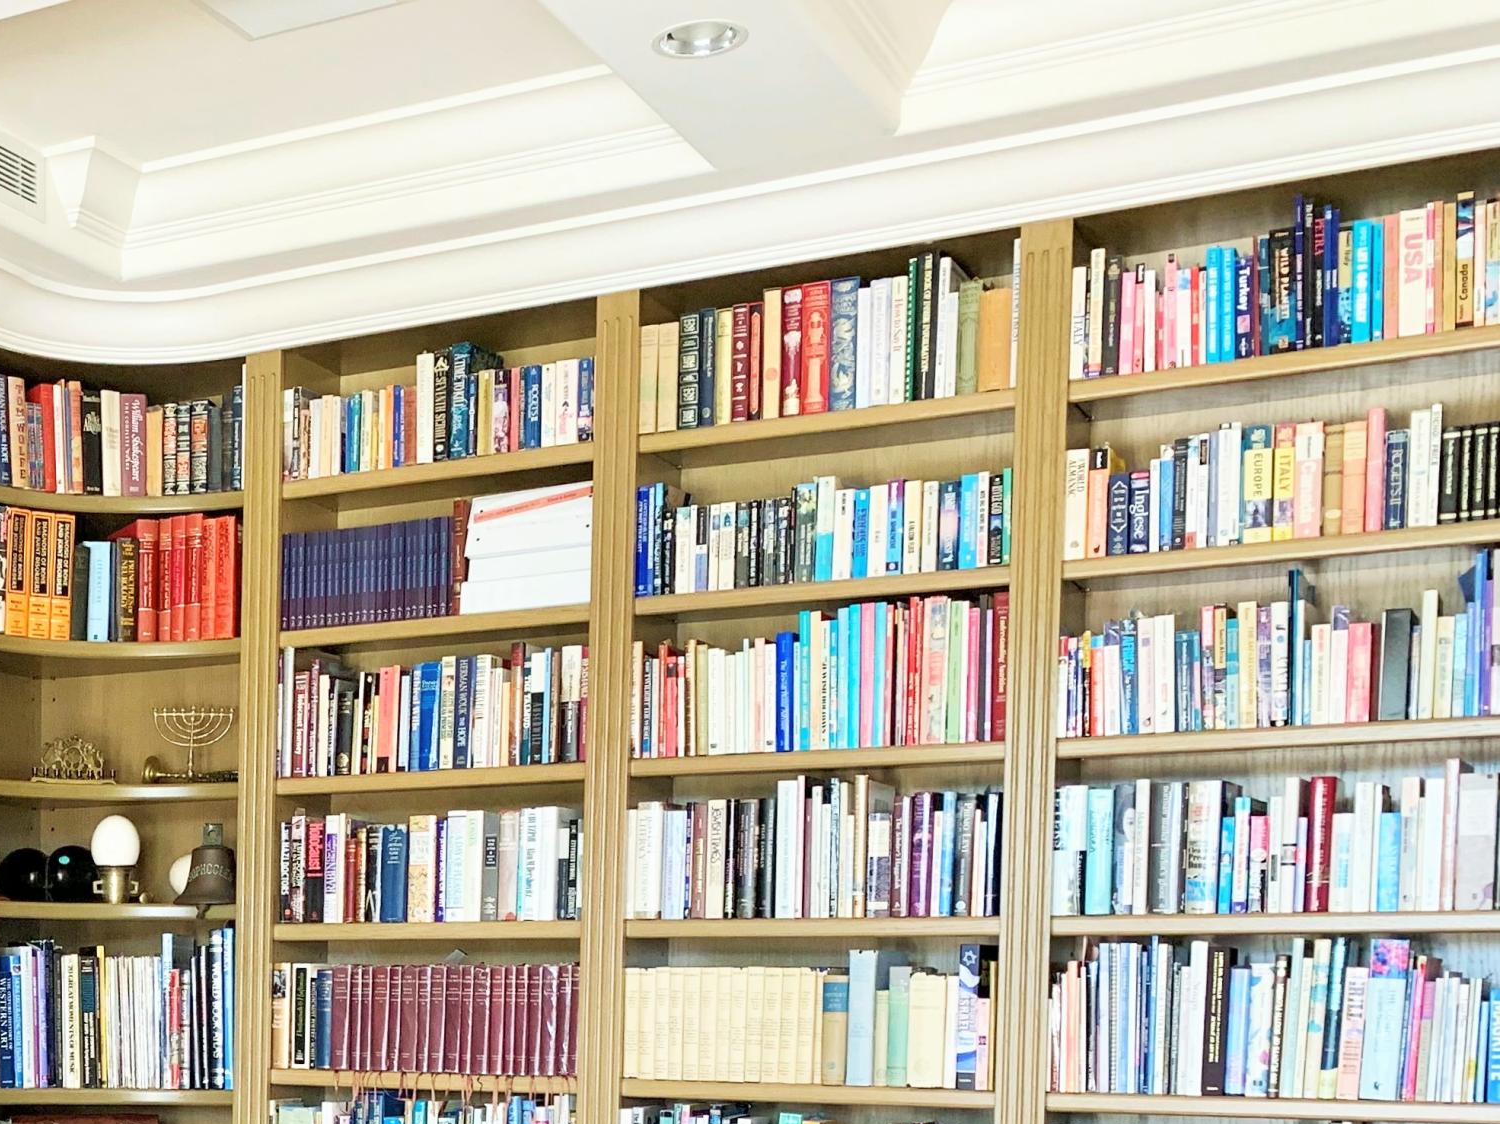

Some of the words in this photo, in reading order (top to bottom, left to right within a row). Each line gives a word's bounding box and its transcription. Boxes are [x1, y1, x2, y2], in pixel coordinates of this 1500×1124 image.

[1314, 218, 1325, 256] PETRA
[1404, 232, 1424, 284] USA
[1237, 267, 1250, 311] Turkey
[130, 400, 140, 433] William
[434, 413, 446, 444] SCROLL
[1, 444, 9, 462] HOPE
[129, 436, 141, 481] Shakespeare
[1253, 453, 1263, 497] EUROPE
[1278, 455, 1291, 492] ITALY
[1130, 490, 1148, 539] Inglese
[459, 659, 467, 691] HERMAN
[459, 693, 467, 714] WOUK
[457, 727, 466, 747] HOPE
[308, 823, 323, 870] Holocaust
[0, 978, 7, 1026] WESTERN
[0, 1030, 8, 1050] ART
